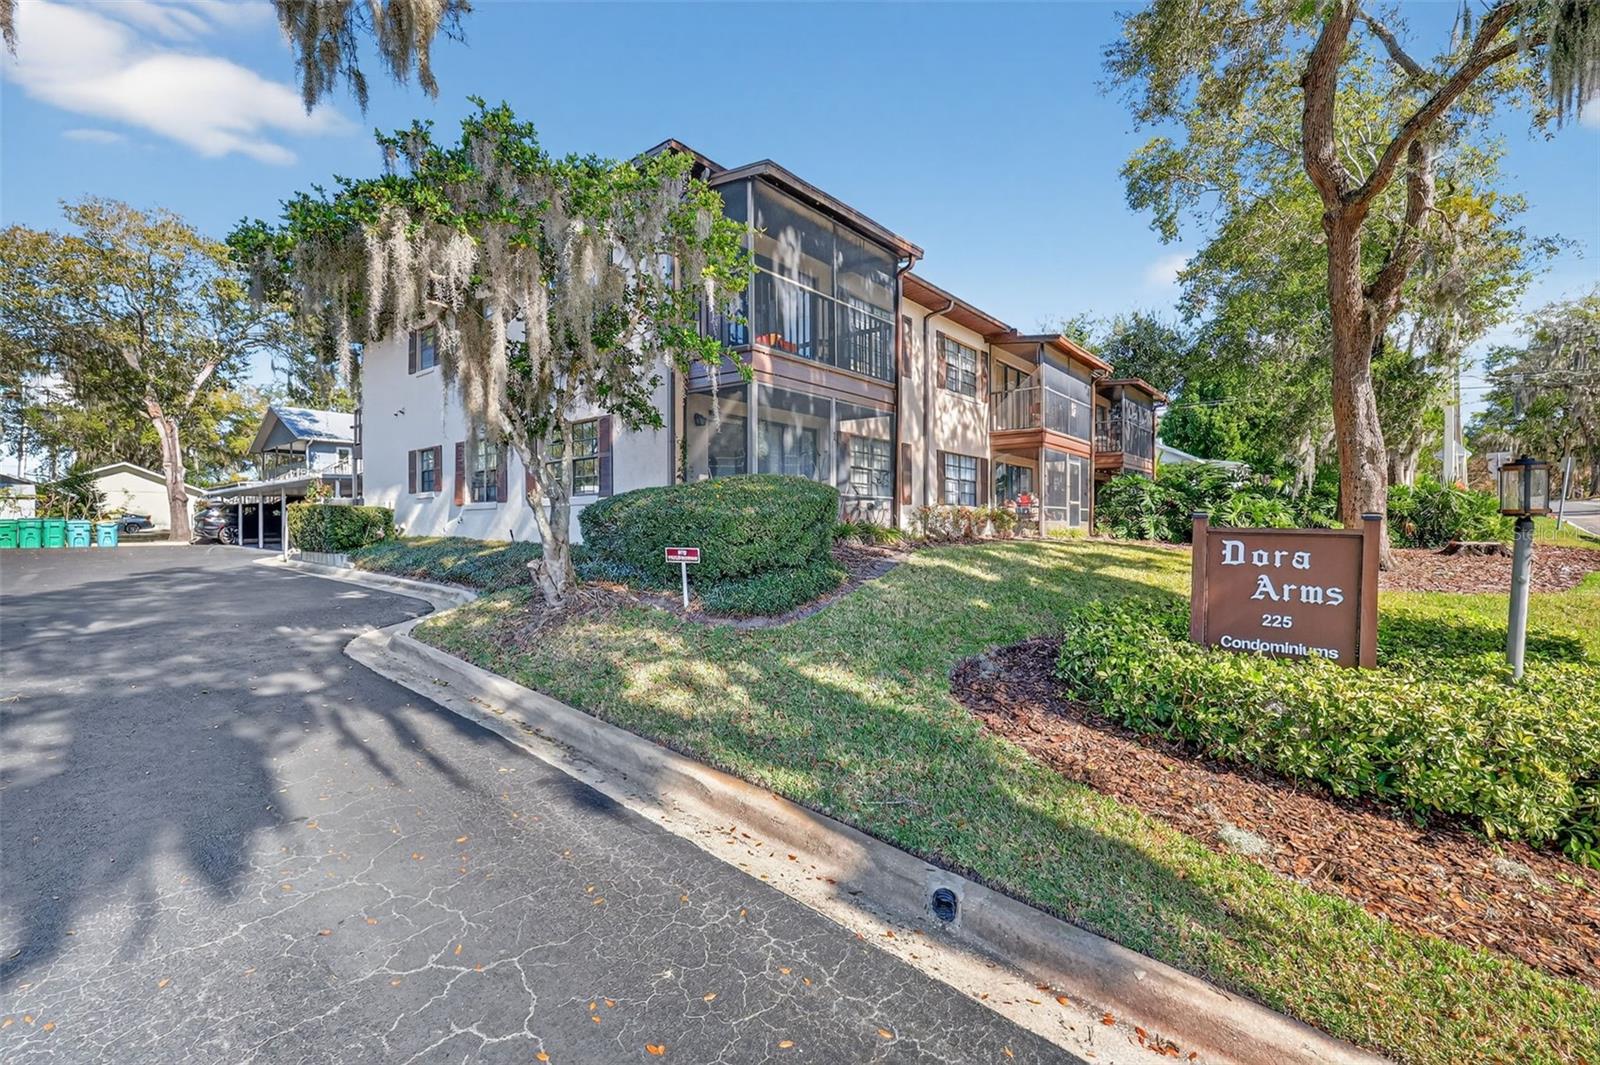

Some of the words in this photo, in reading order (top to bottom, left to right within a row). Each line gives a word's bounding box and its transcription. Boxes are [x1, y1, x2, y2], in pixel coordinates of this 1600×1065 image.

[1221, 540, 1312, 569] Dora
[1250, 574, 1344, 606] Arms
[1262, 614, 1293, 629] 225
